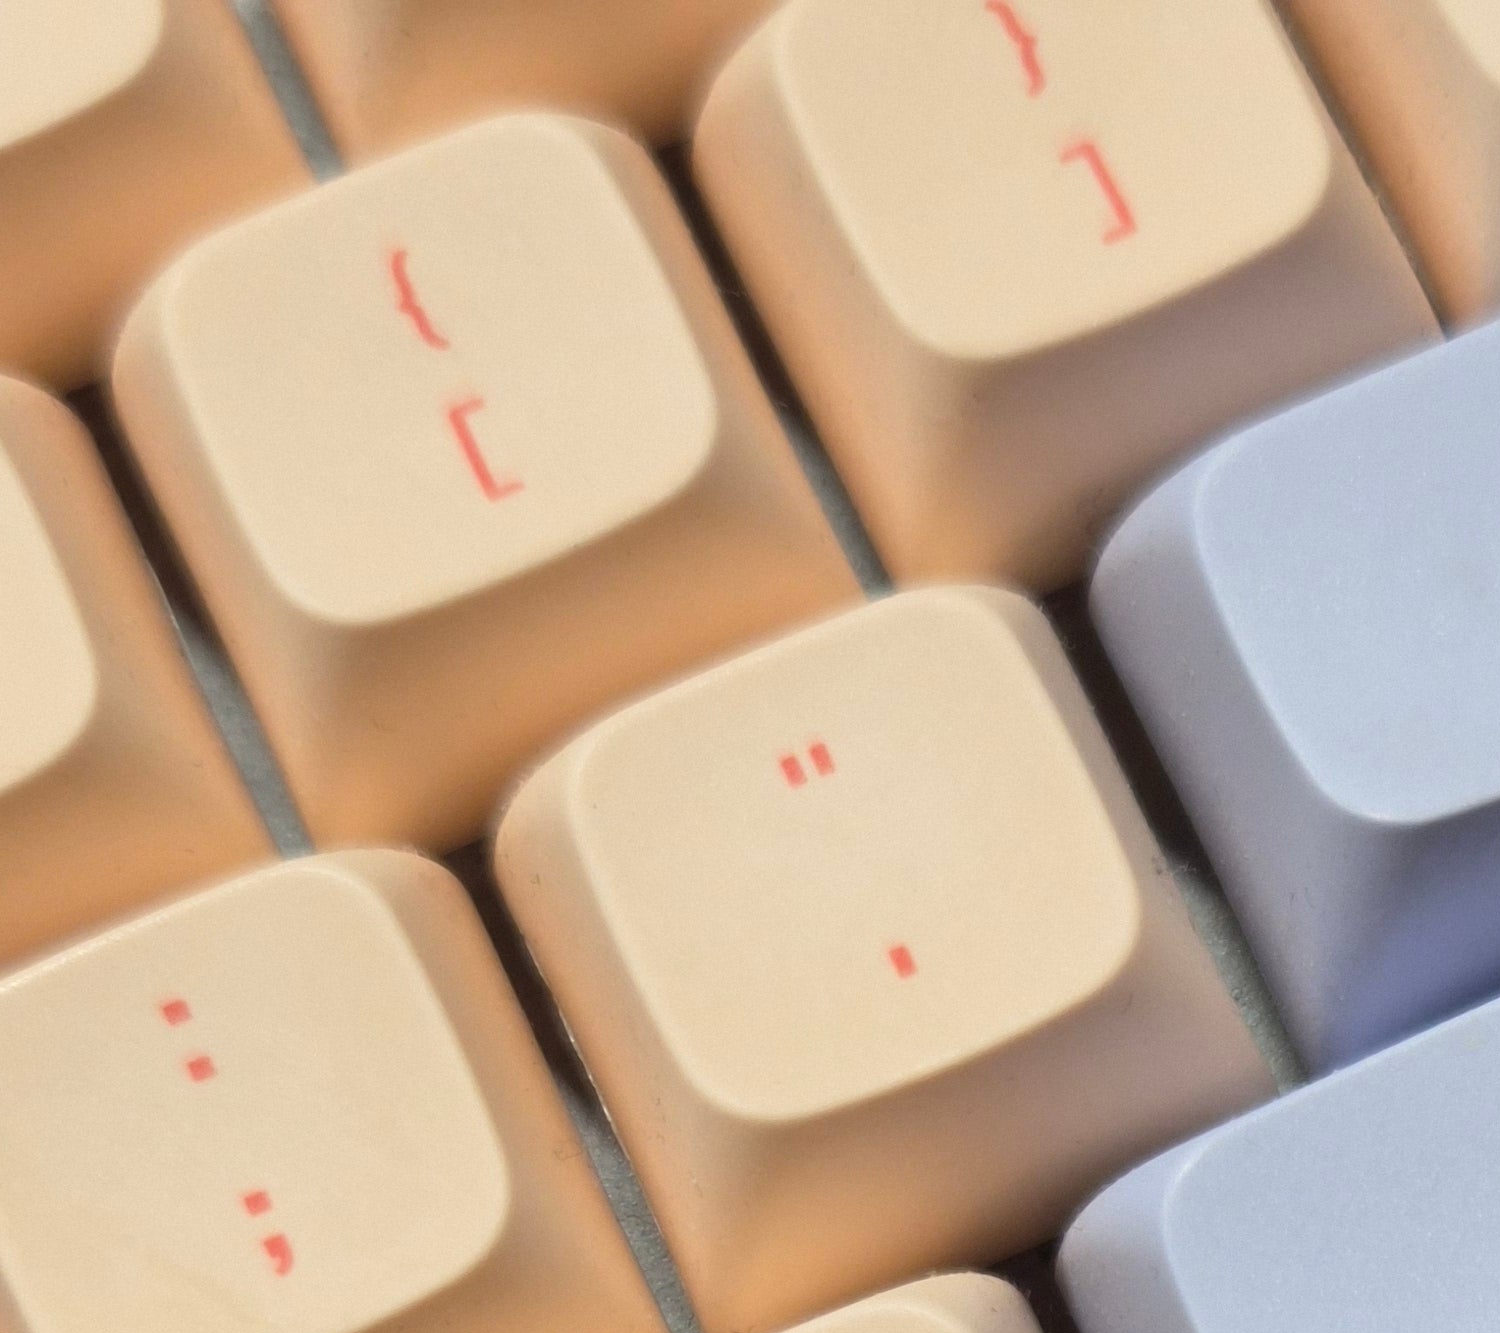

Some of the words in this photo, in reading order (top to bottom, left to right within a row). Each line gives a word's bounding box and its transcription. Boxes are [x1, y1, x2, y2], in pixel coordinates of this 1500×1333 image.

[1060, 138, 1137, 245] ]
[386, 248, 448, 350] {
[445, 397, 523, 501] [
[778, 742, 835, 788] "
[159, 998, 214, 1083] :
[240, 1190, 293, 1277] ;
